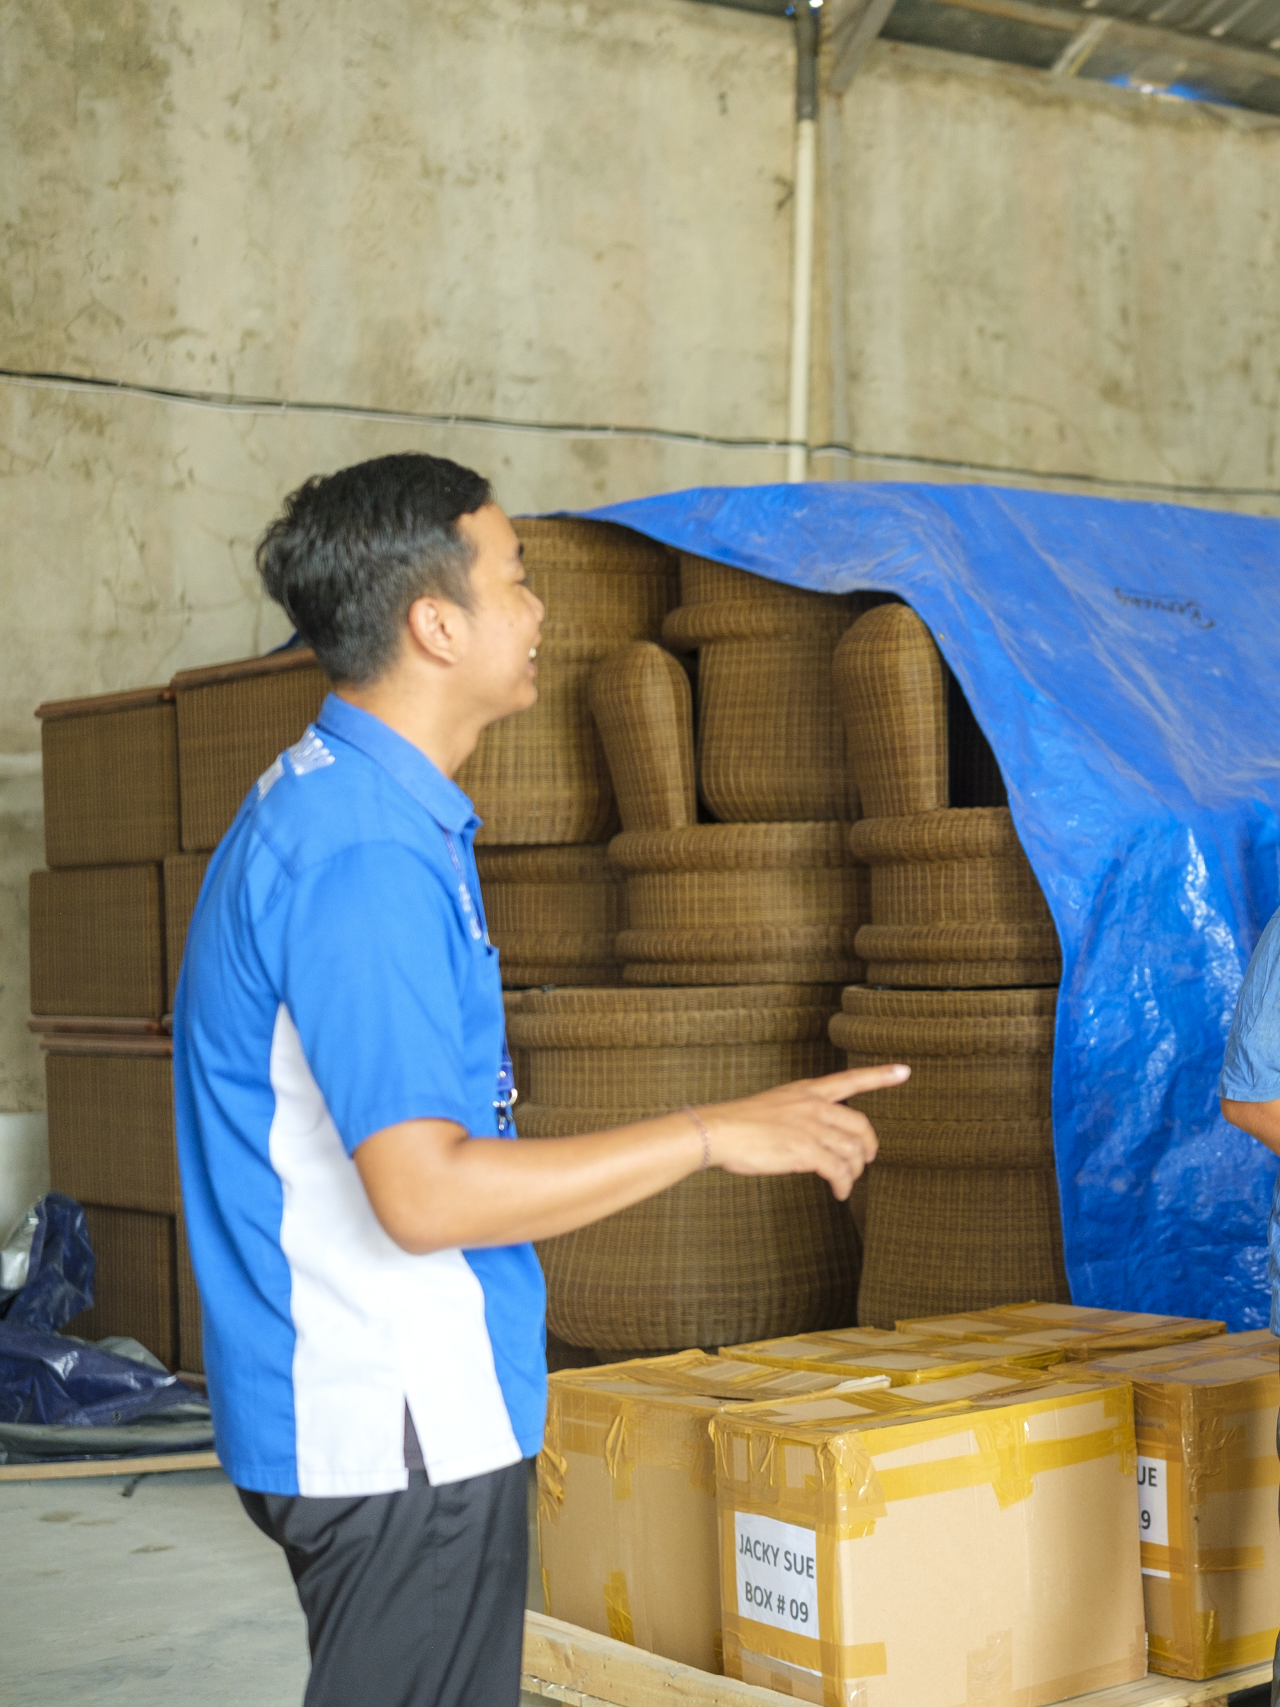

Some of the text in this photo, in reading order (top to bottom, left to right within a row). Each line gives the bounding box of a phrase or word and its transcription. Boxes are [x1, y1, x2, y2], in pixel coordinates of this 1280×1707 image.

[1137, 1465, 1157, 1487] UE
[1139, 1509, 1151, 1530] 9
[739, 1533, 815, 1579] JACKY SUE
[745, 1581, 809, 1623] BOX # 09
